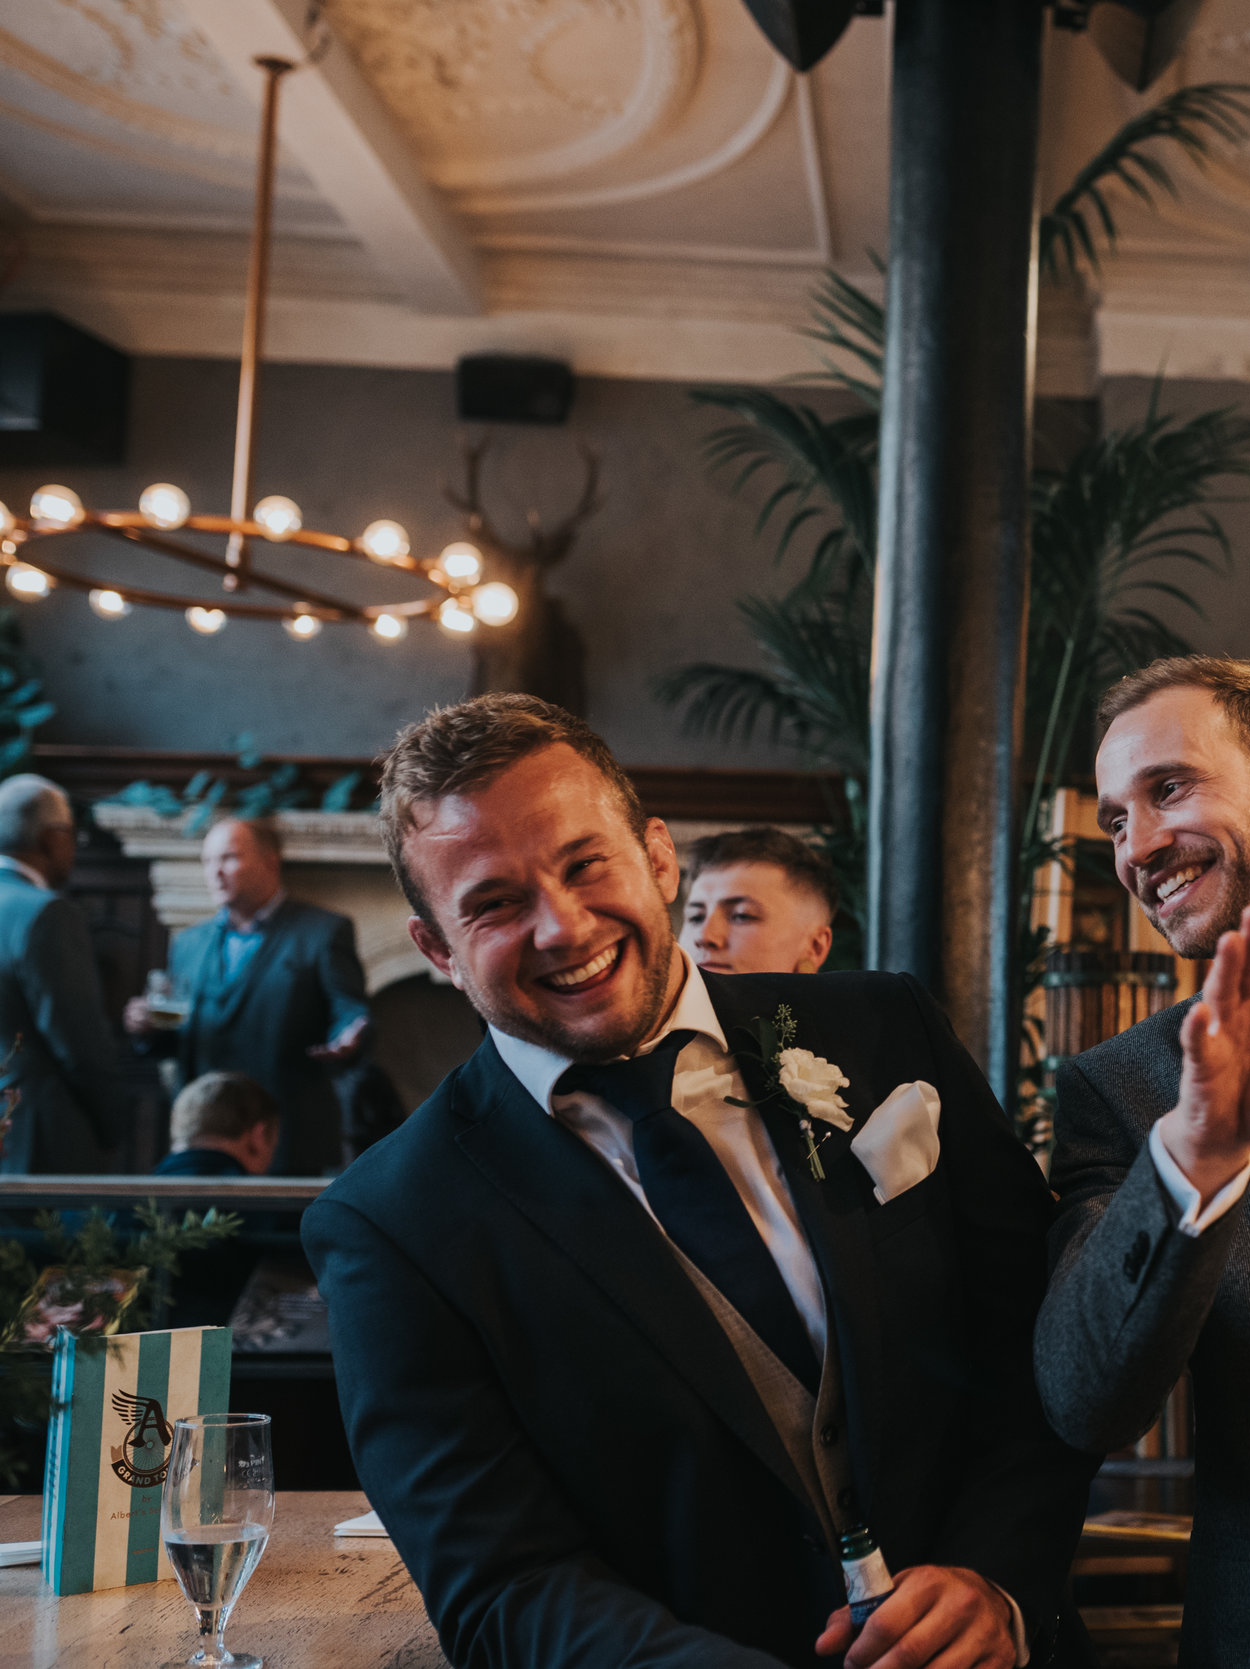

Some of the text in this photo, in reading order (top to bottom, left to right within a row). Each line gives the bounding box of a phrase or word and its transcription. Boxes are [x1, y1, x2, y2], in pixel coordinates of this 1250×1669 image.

[117, 1465, 168, 1485] GRAND TO
[141, 1494, 153, 1504] by
